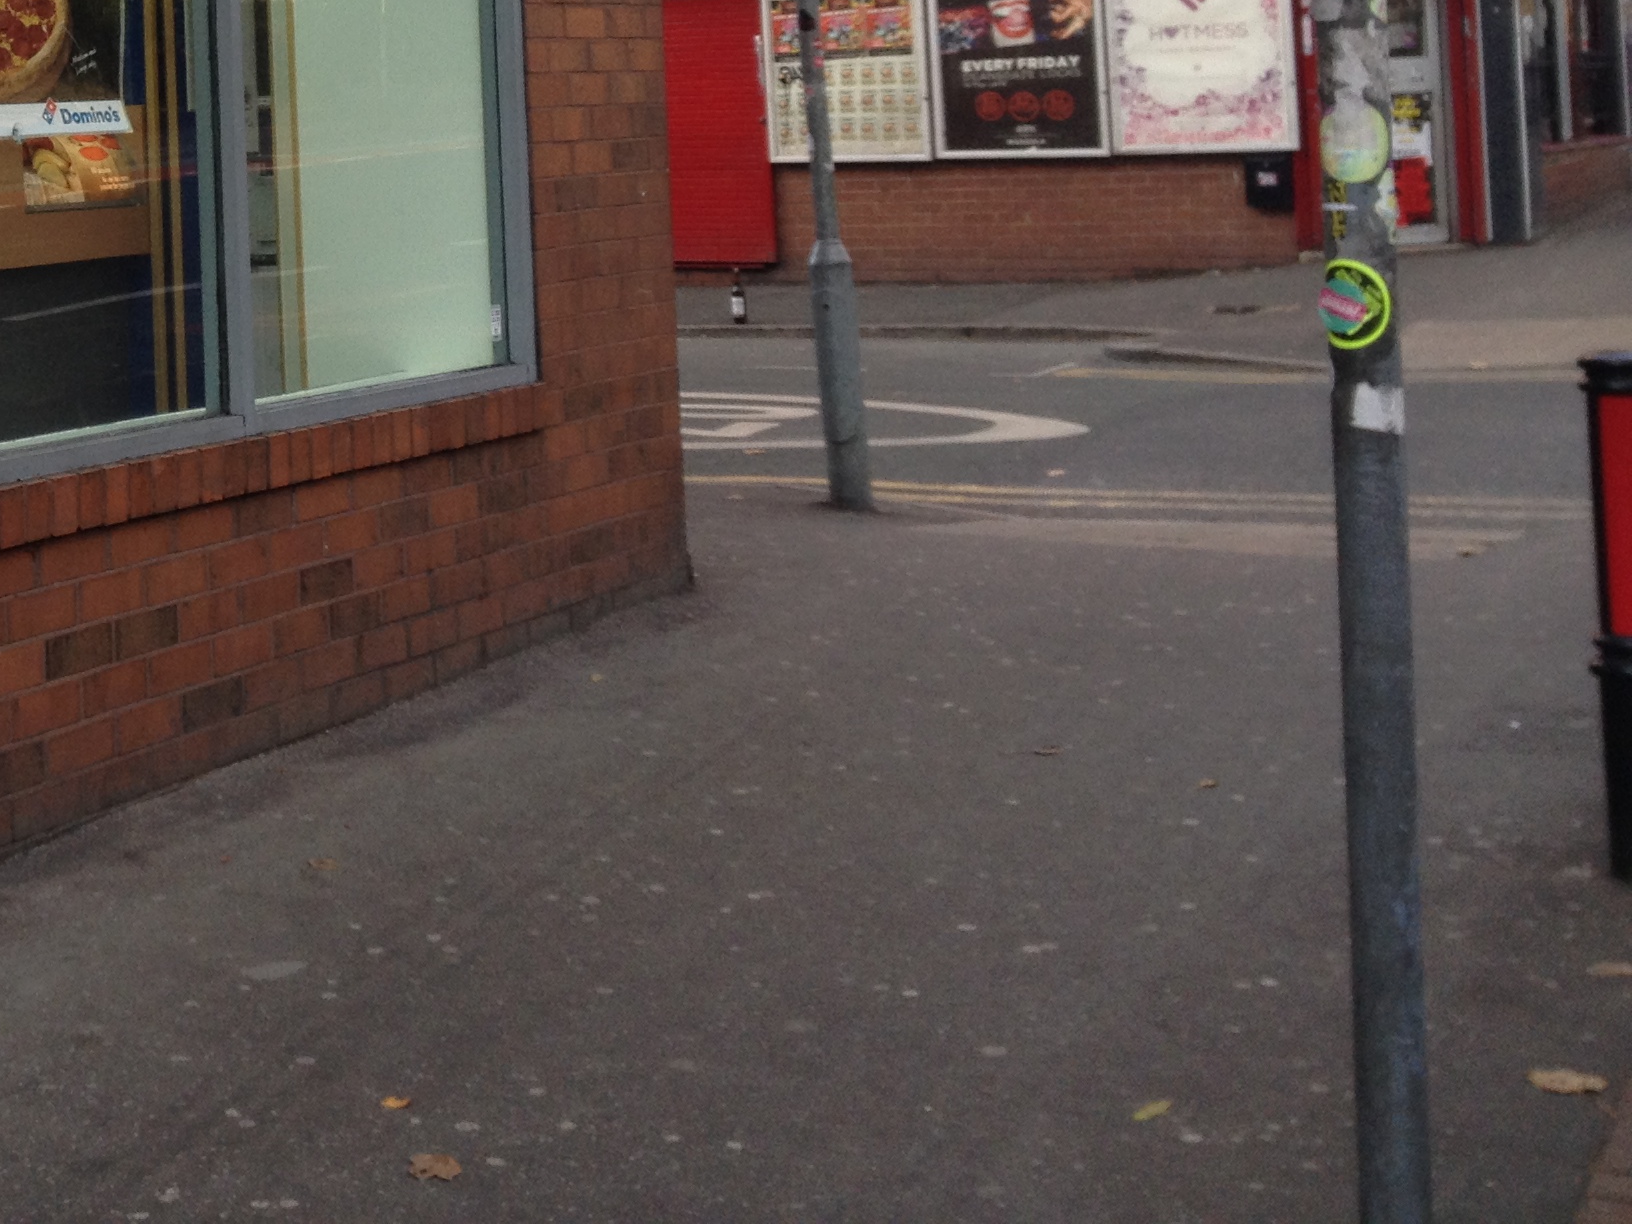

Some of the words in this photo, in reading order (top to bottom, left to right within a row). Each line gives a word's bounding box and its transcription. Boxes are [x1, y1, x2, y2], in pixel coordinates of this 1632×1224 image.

[960, 57, 1015, 73] EVERY
[1017, 54, 1082, 70] FRIDAY
[59, 103, 122, 127] Domino's
